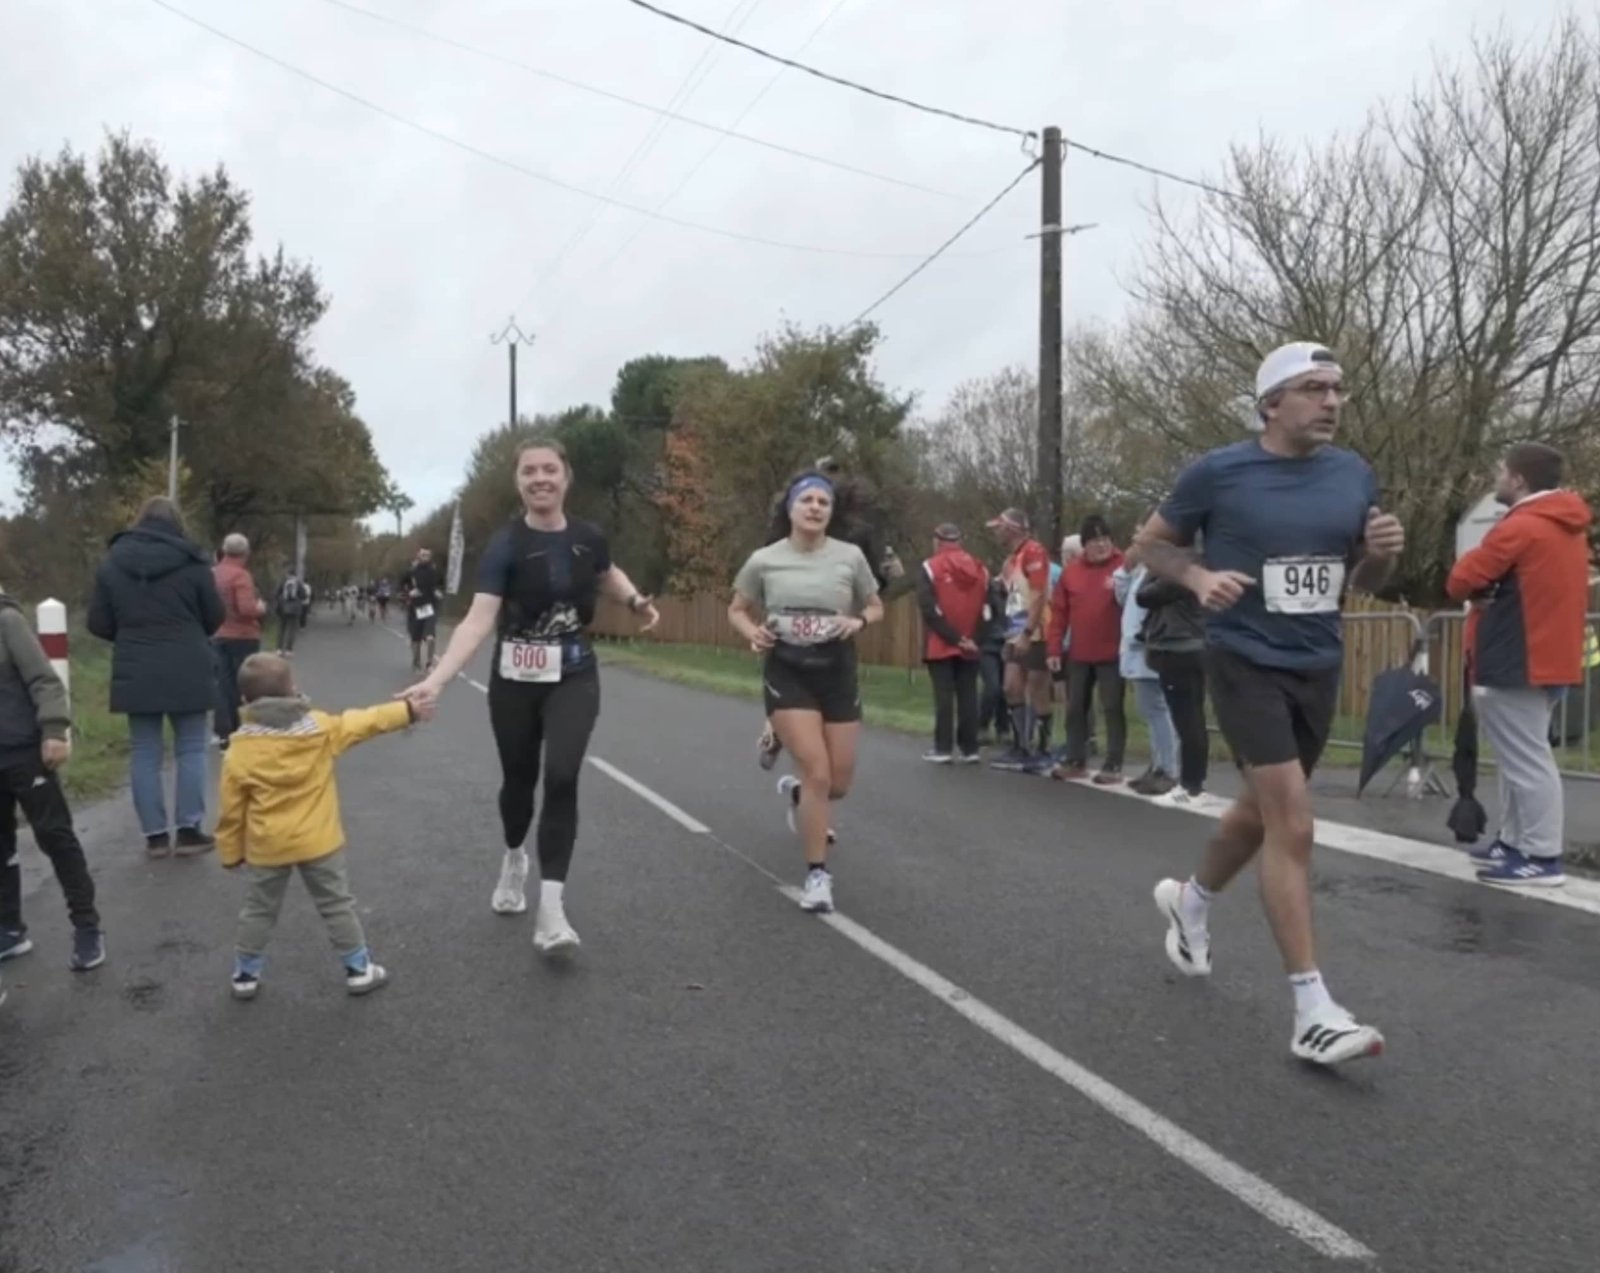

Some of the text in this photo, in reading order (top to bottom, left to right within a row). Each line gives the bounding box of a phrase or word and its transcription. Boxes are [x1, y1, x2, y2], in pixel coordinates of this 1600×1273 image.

[1285, 565, 1330, 595] 946
[792, 615, 821, 637] 582
[513, 643, 547, 669] 600
